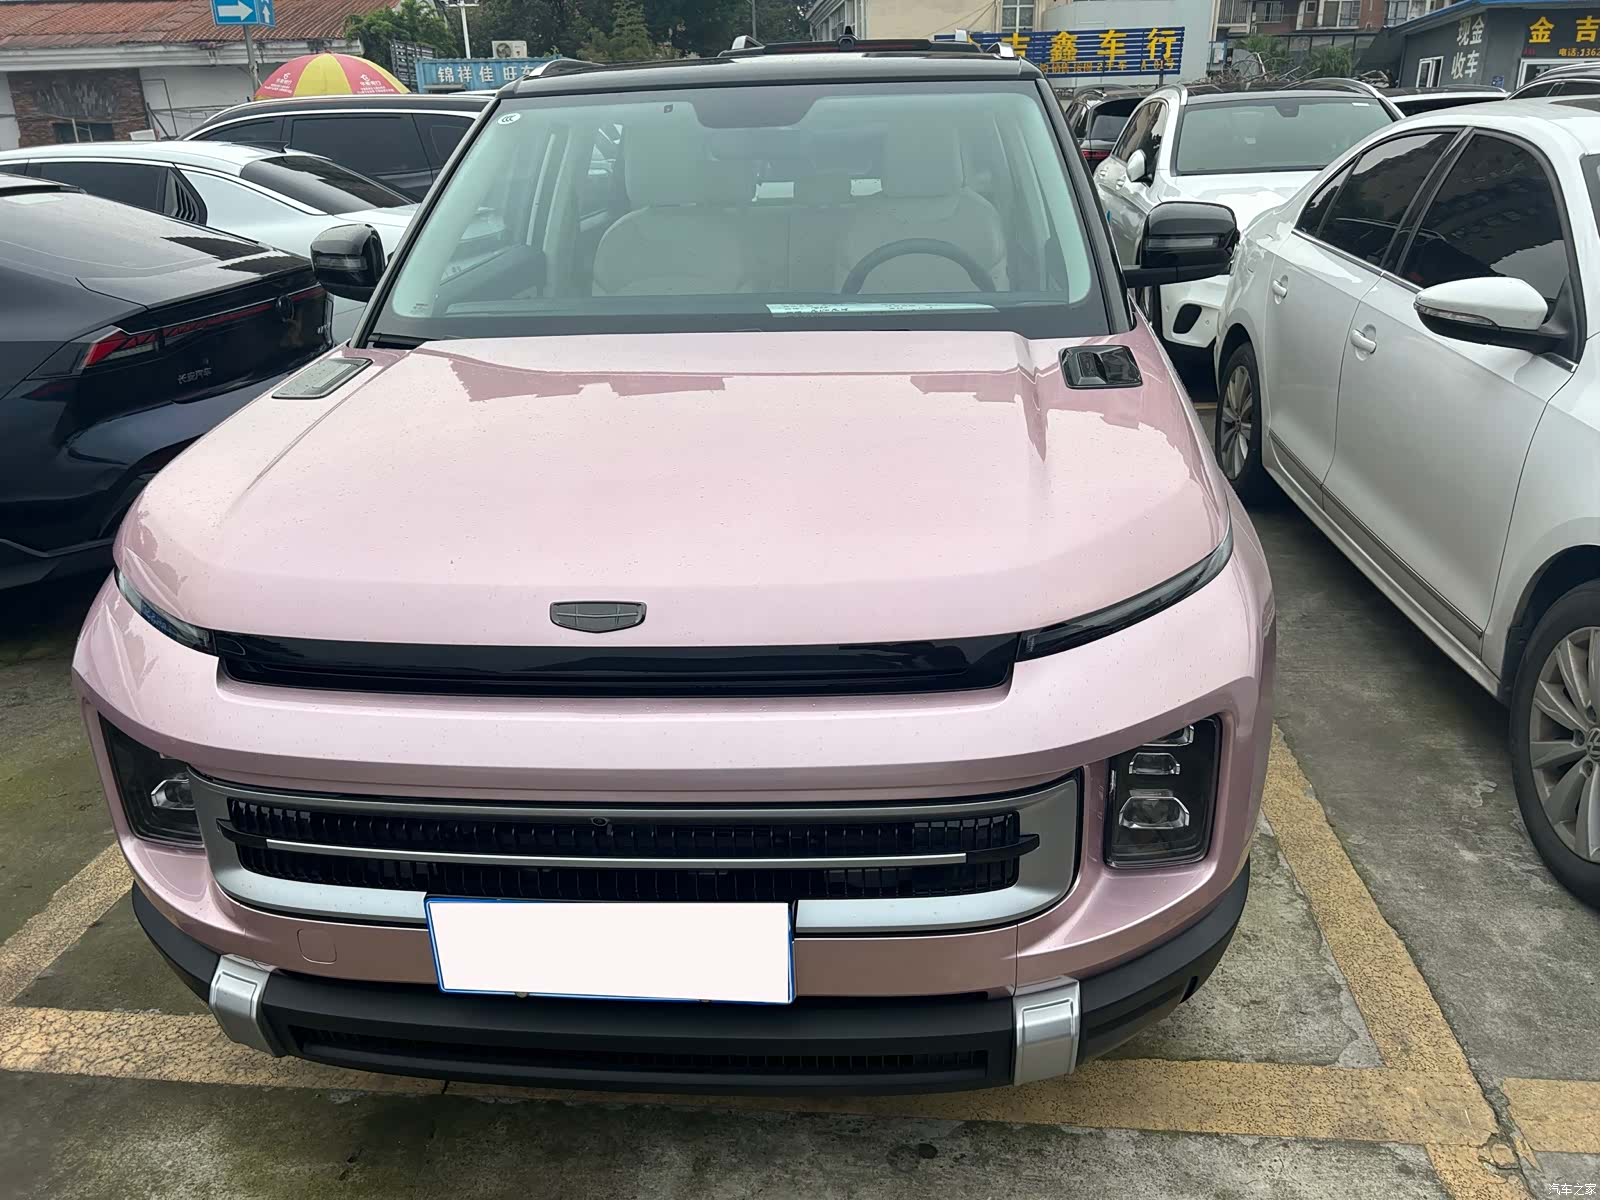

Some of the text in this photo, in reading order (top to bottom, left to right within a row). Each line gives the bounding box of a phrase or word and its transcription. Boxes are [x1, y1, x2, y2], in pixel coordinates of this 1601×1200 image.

[967, 28, 1177, 62] 吉鑫车行
[1457, 16, 1485, 46] 现金
[1451, 50, 1480, 79] 收车
